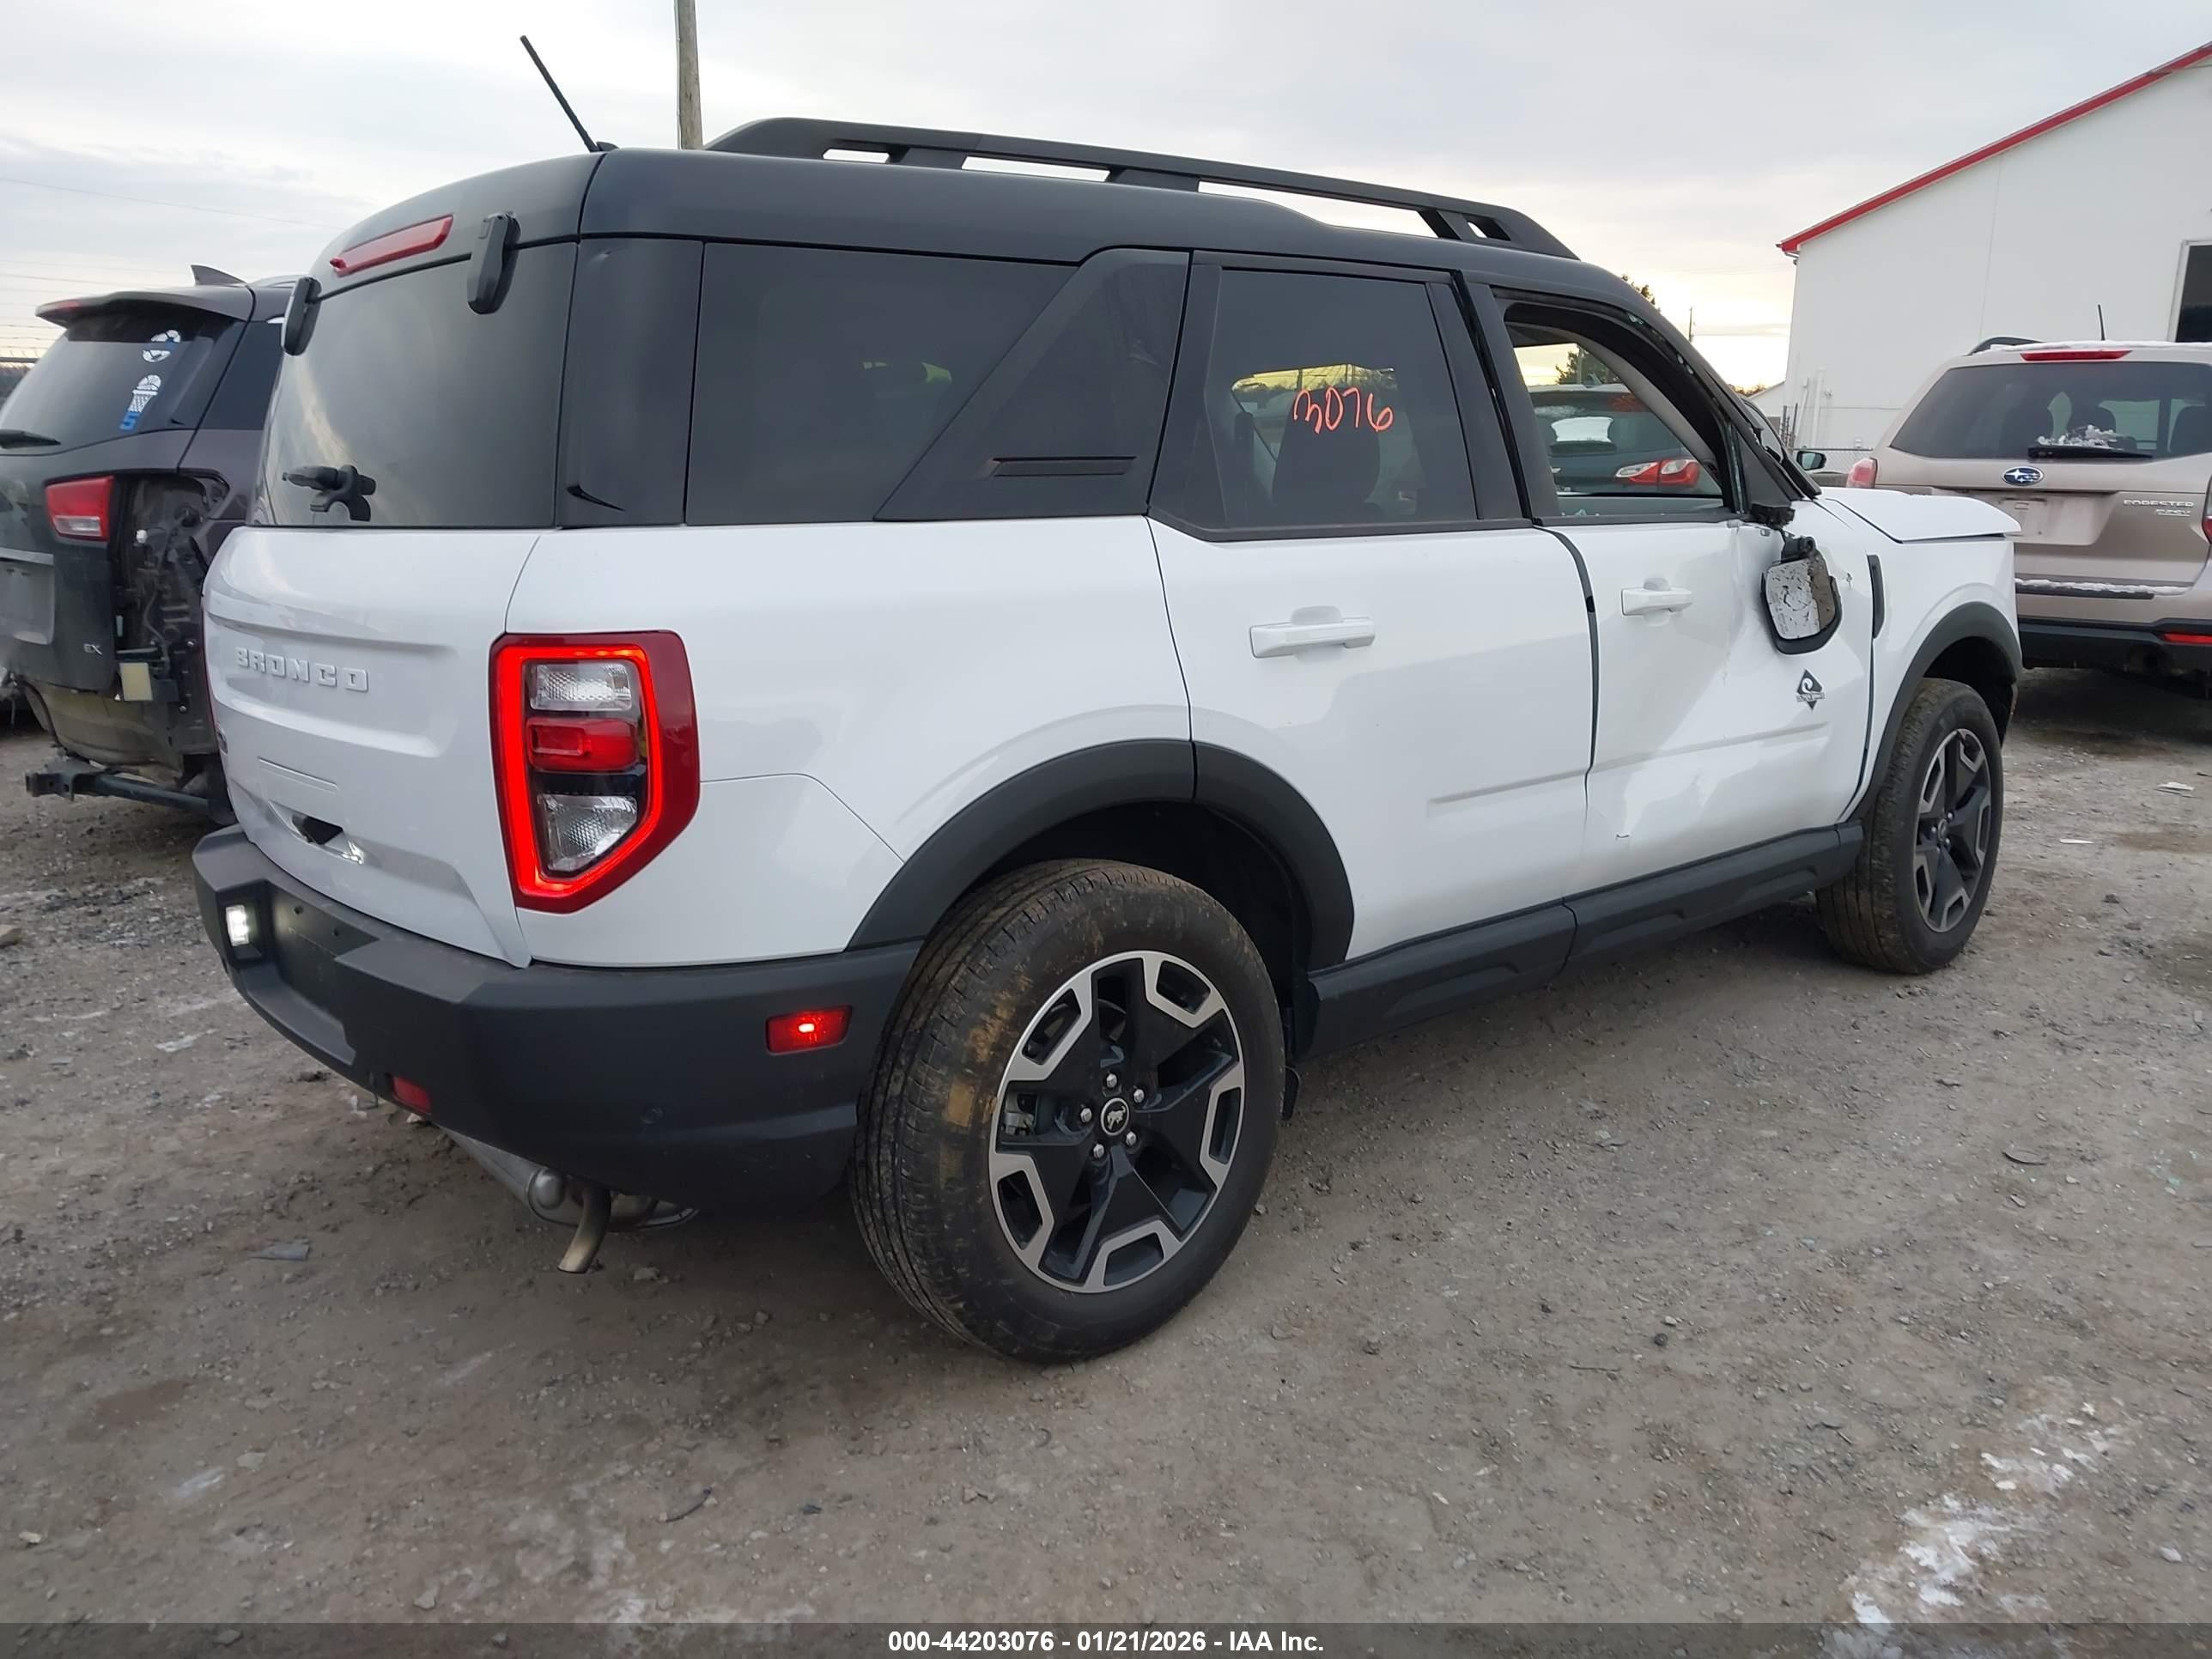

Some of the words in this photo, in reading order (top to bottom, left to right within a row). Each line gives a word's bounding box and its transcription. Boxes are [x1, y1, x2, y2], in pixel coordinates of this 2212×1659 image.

[1293, 386, 1394, 434] 3076
[83, 643, 103, 655] EX
[234, 647, 368, 692] BRONCO
